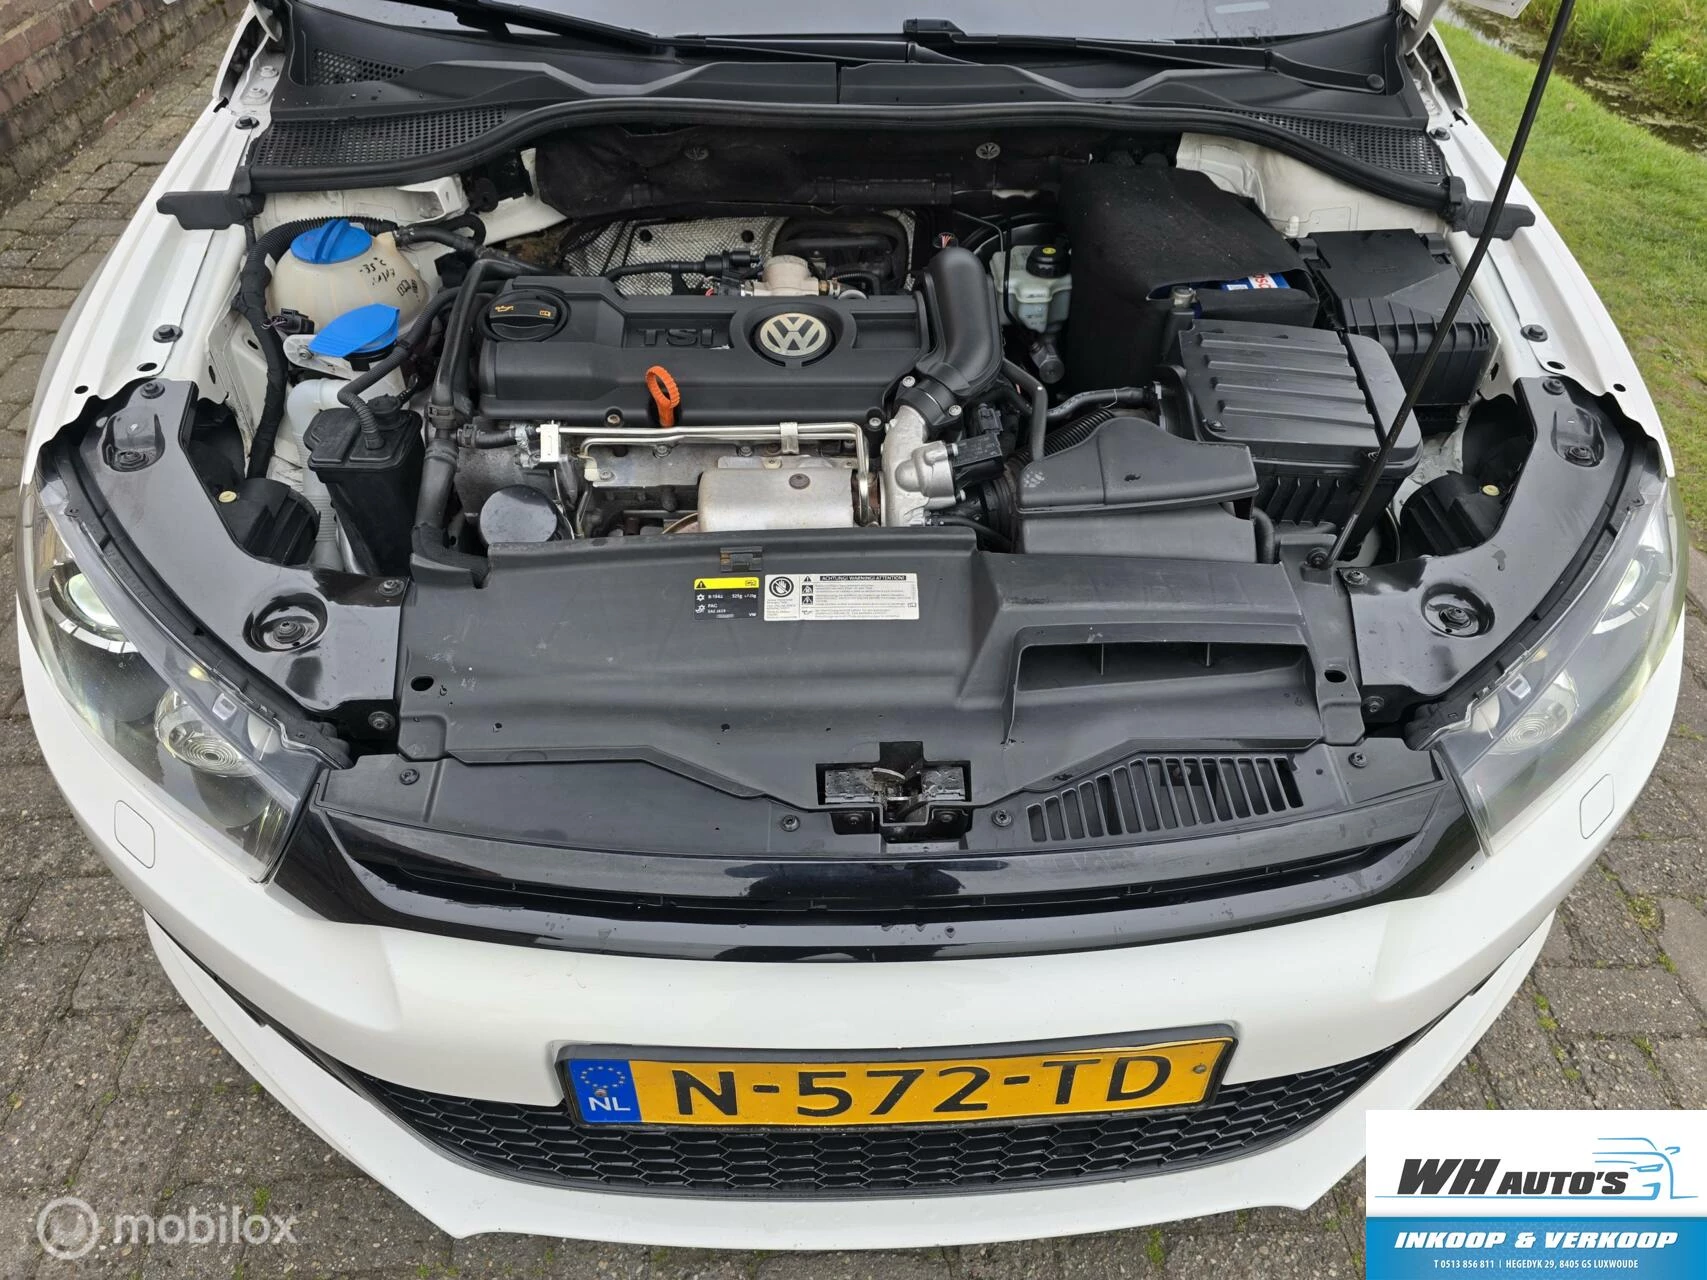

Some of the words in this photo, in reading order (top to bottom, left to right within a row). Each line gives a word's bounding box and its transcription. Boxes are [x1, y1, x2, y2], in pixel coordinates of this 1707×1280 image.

[637, 328, 715, 347] TSI
[760, 312, 827, 357] VW
[672, 1054, 1172, 1118] N-572-TD
[588, 1096, 631, 1111] NL
